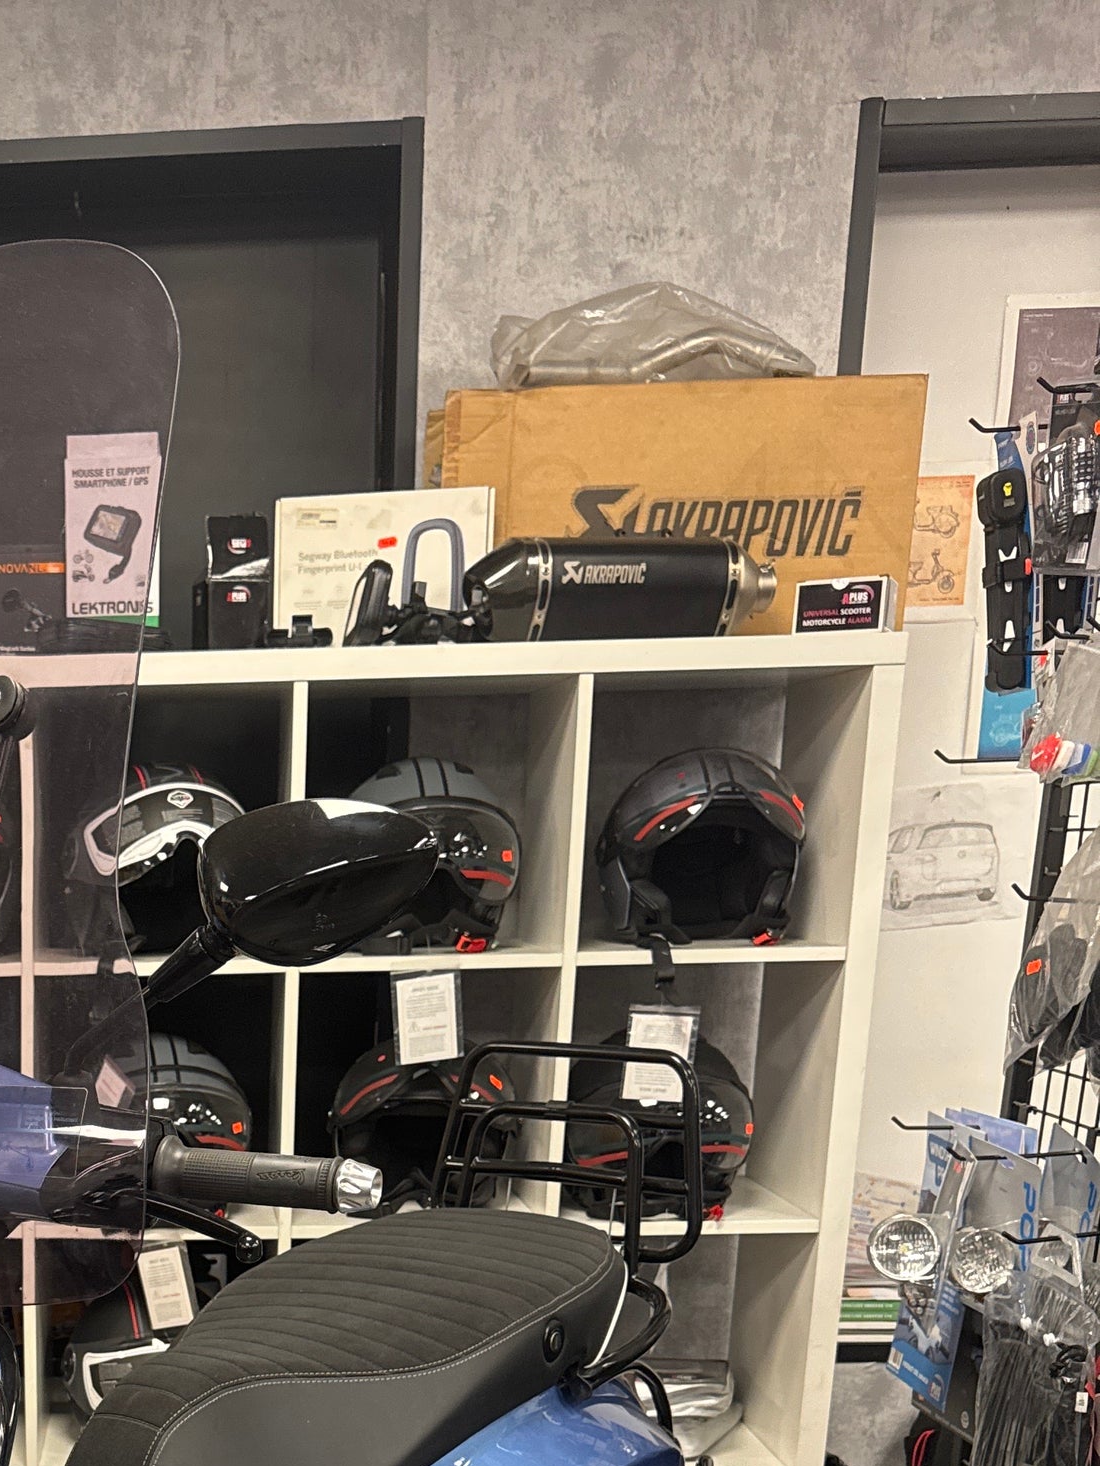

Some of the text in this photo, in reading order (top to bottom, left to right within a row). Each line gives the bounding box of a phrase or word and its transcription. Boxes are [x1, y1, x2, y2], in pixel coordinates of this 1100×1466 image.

[72, 466, 150, 478] HOUSSE ET SUPPORT
[74, 479, 127, 489] SMARTPHONE
[134, 477, 148, 485] GPS
[299, 549, 378, 562] Segway Bluetooth
[298, 564, 346, 576] Fingerprint
[803, 607, 871, 617] UNIVERSAL SCOOTER
[802, 617, 871, 626] MOTORCYCLE ALARM
